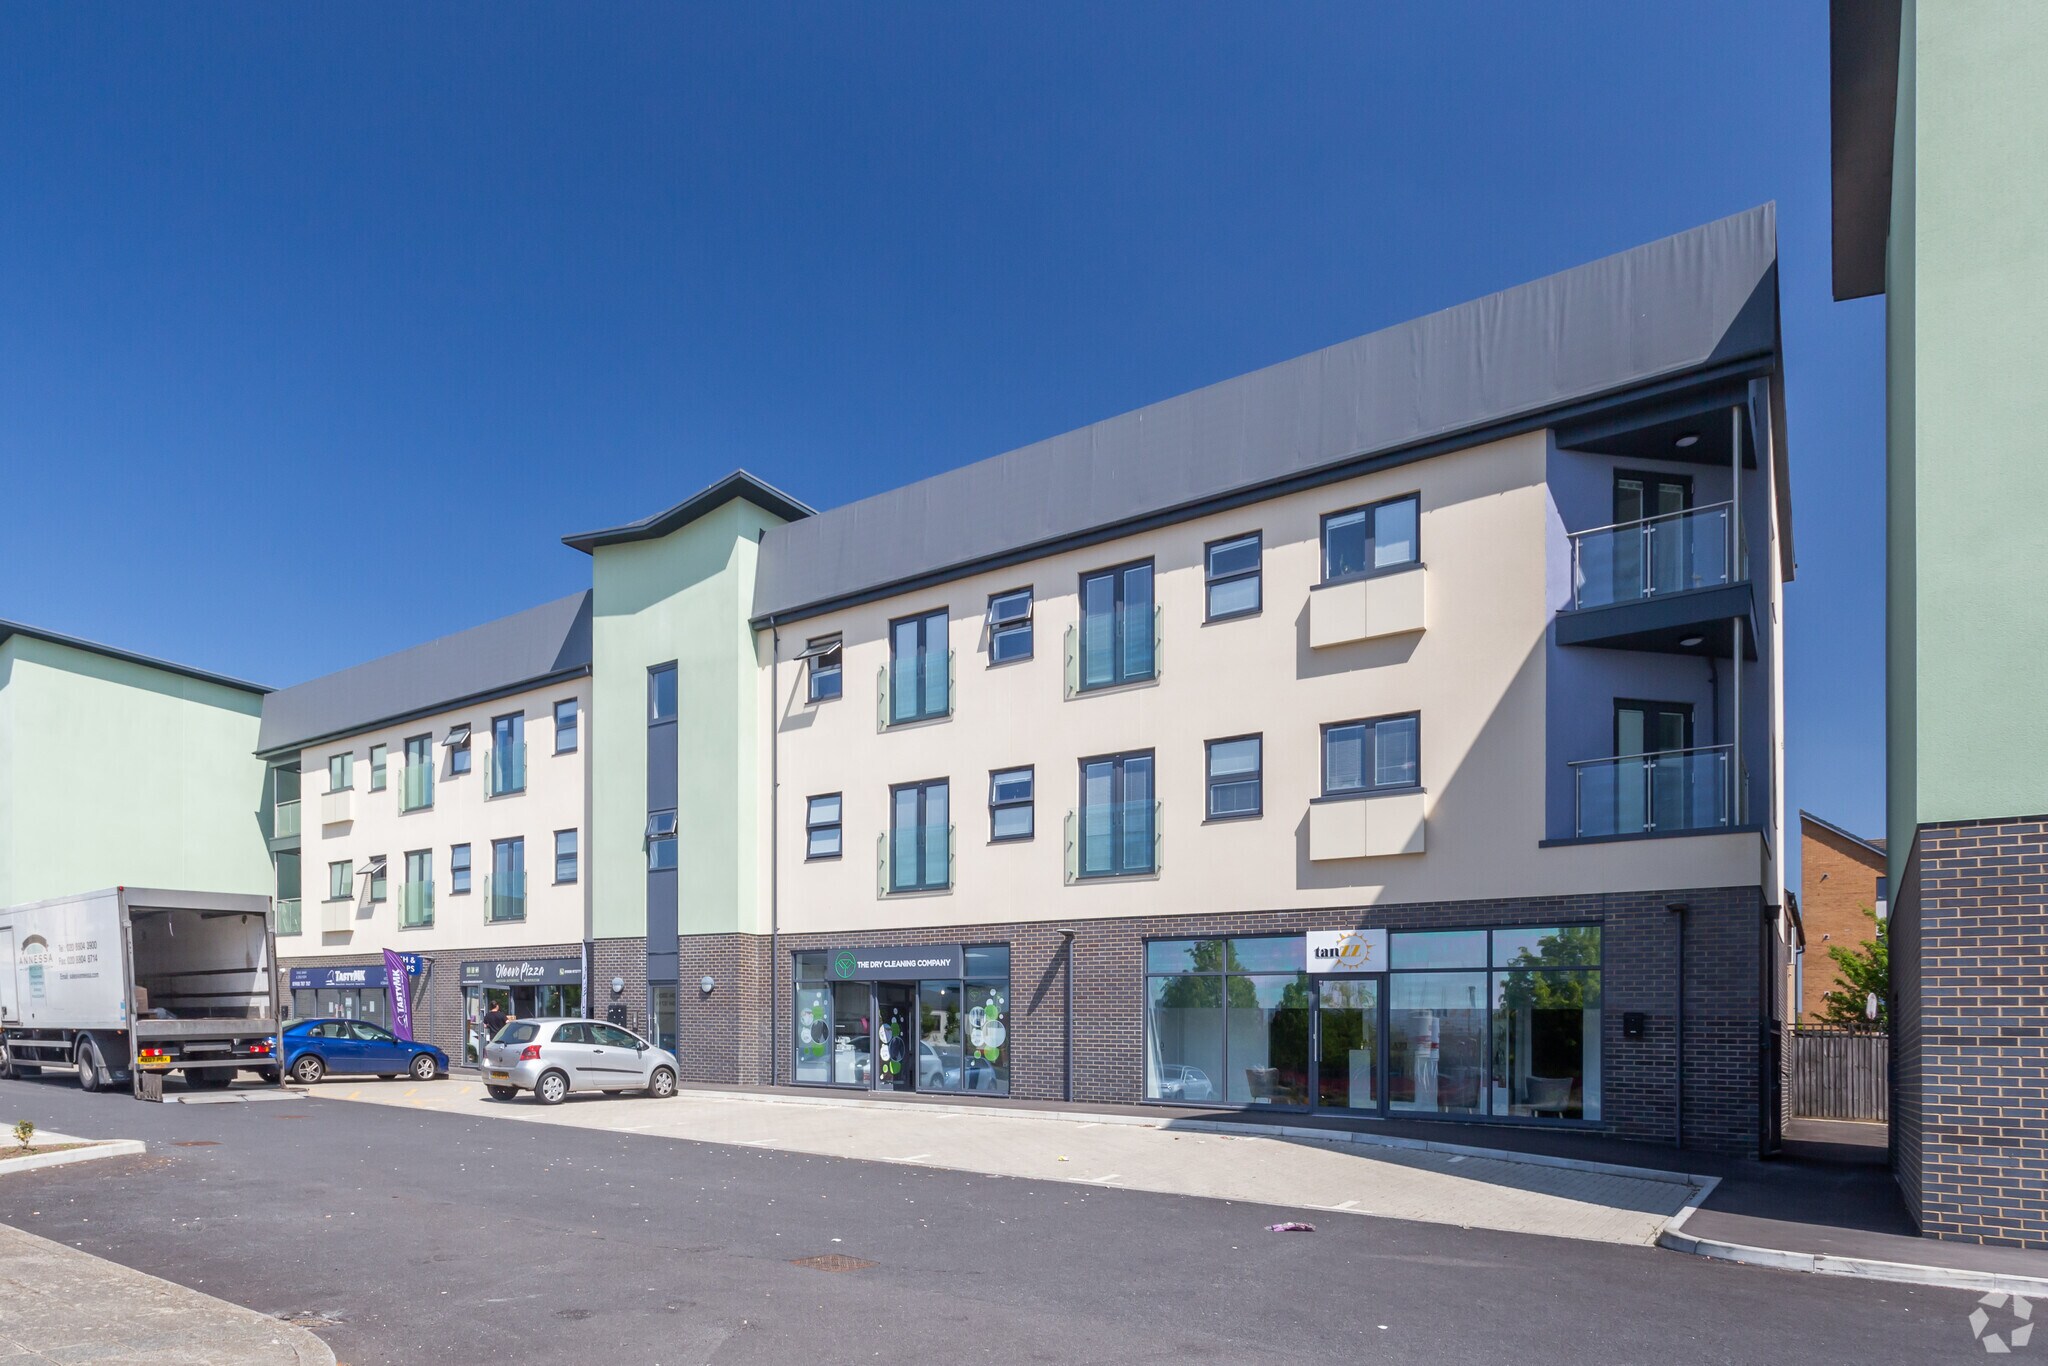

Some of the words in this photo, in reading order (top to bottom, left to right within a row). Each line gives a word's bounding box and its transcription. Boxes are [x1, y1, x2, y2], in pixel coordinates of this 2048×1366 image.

[19, 953, 53, 965] ANNESSA
[857, 961, 870, 969] THE
[884, 960, 916, 968] CLEANING
[917, 959, 951, 967] COMPANY
[520, 961, 545, 980] Pizza
[391, 968, 405, 1014] TASTYMK
